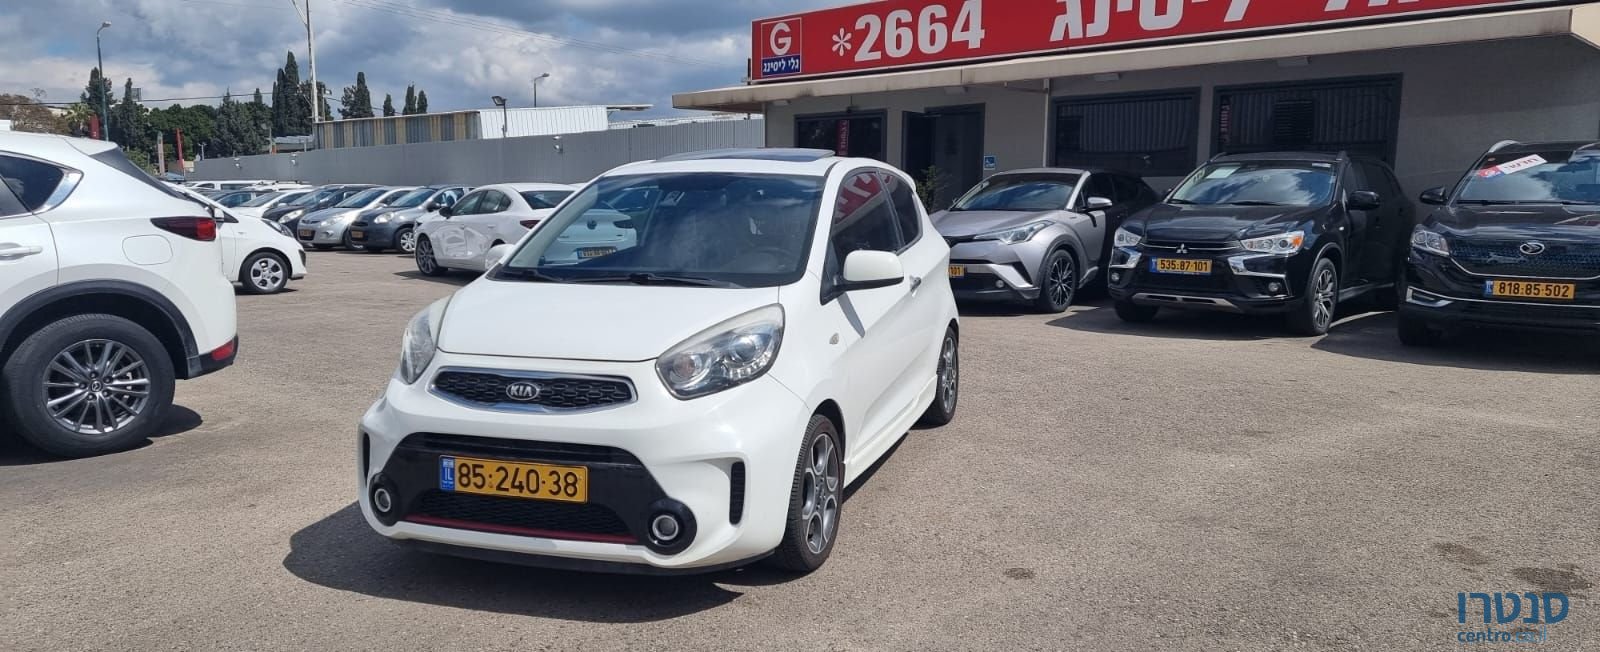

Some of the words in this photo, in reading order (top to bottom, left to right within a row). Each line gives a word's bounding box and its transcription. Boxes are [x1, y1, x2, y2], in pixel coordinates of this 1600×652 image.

[769, 22, 792, 56] G
[762, 58, 787, 73] ליסינג
[787, 57, 800, 71] גלי
[510, 385, 532, 396] KIA
[444, 467, 453, 481] IL
